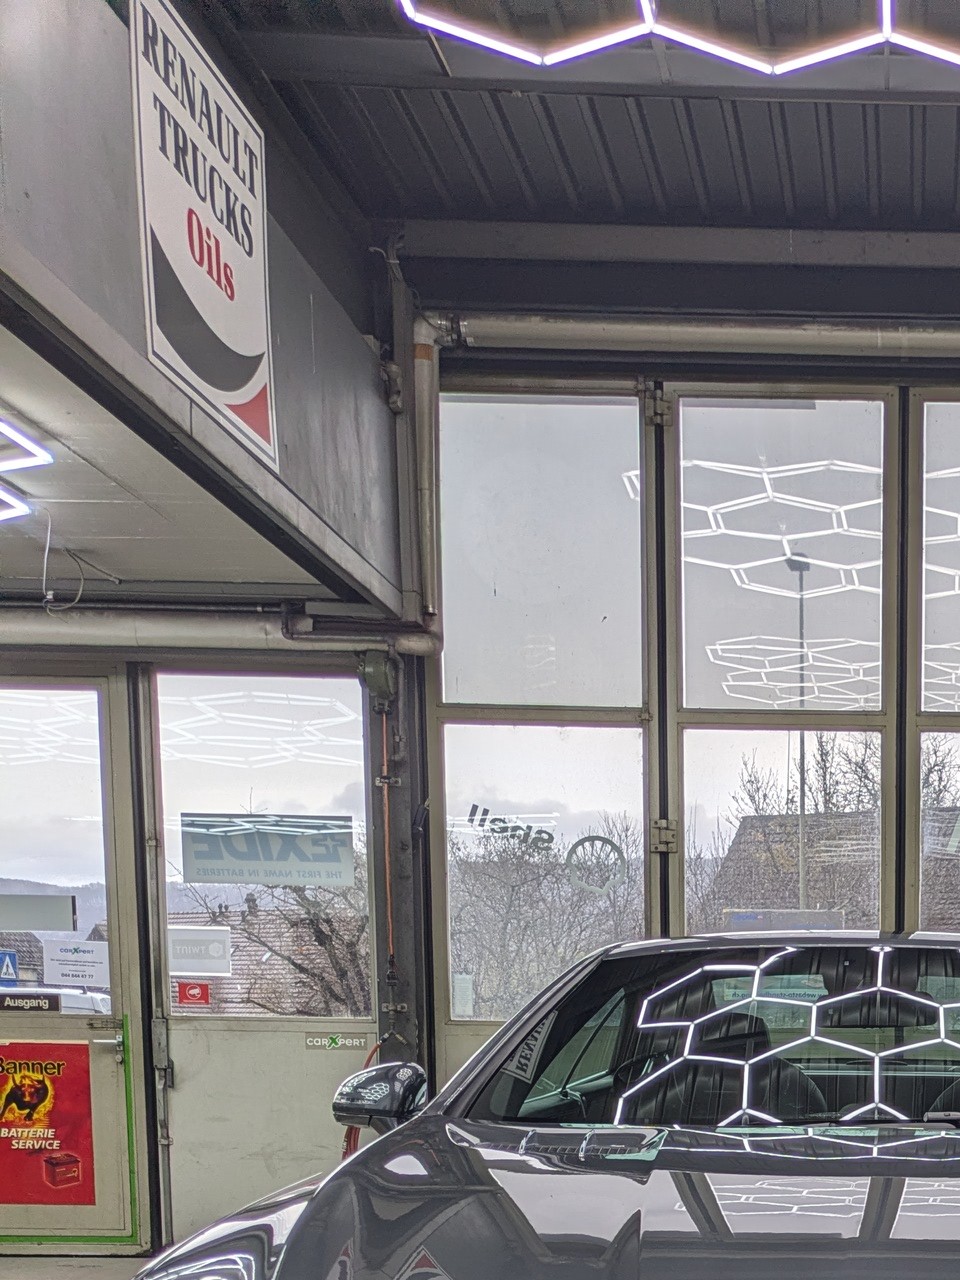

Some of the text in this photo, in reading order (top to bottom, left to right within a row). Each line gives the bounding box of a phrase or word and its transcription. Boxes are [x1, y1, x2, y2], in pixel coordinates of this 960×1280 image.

[140, 1, 260, 199] RENAULT
[152, 92, 254, 258] TRUCKS
[187, 208, 235, 301] Oils
[4, 997, 49, 1009] Ausgang
[0, 1128, 56, 1139] BATTERIE
[11, 1139, 61, 1150] SERVICE
